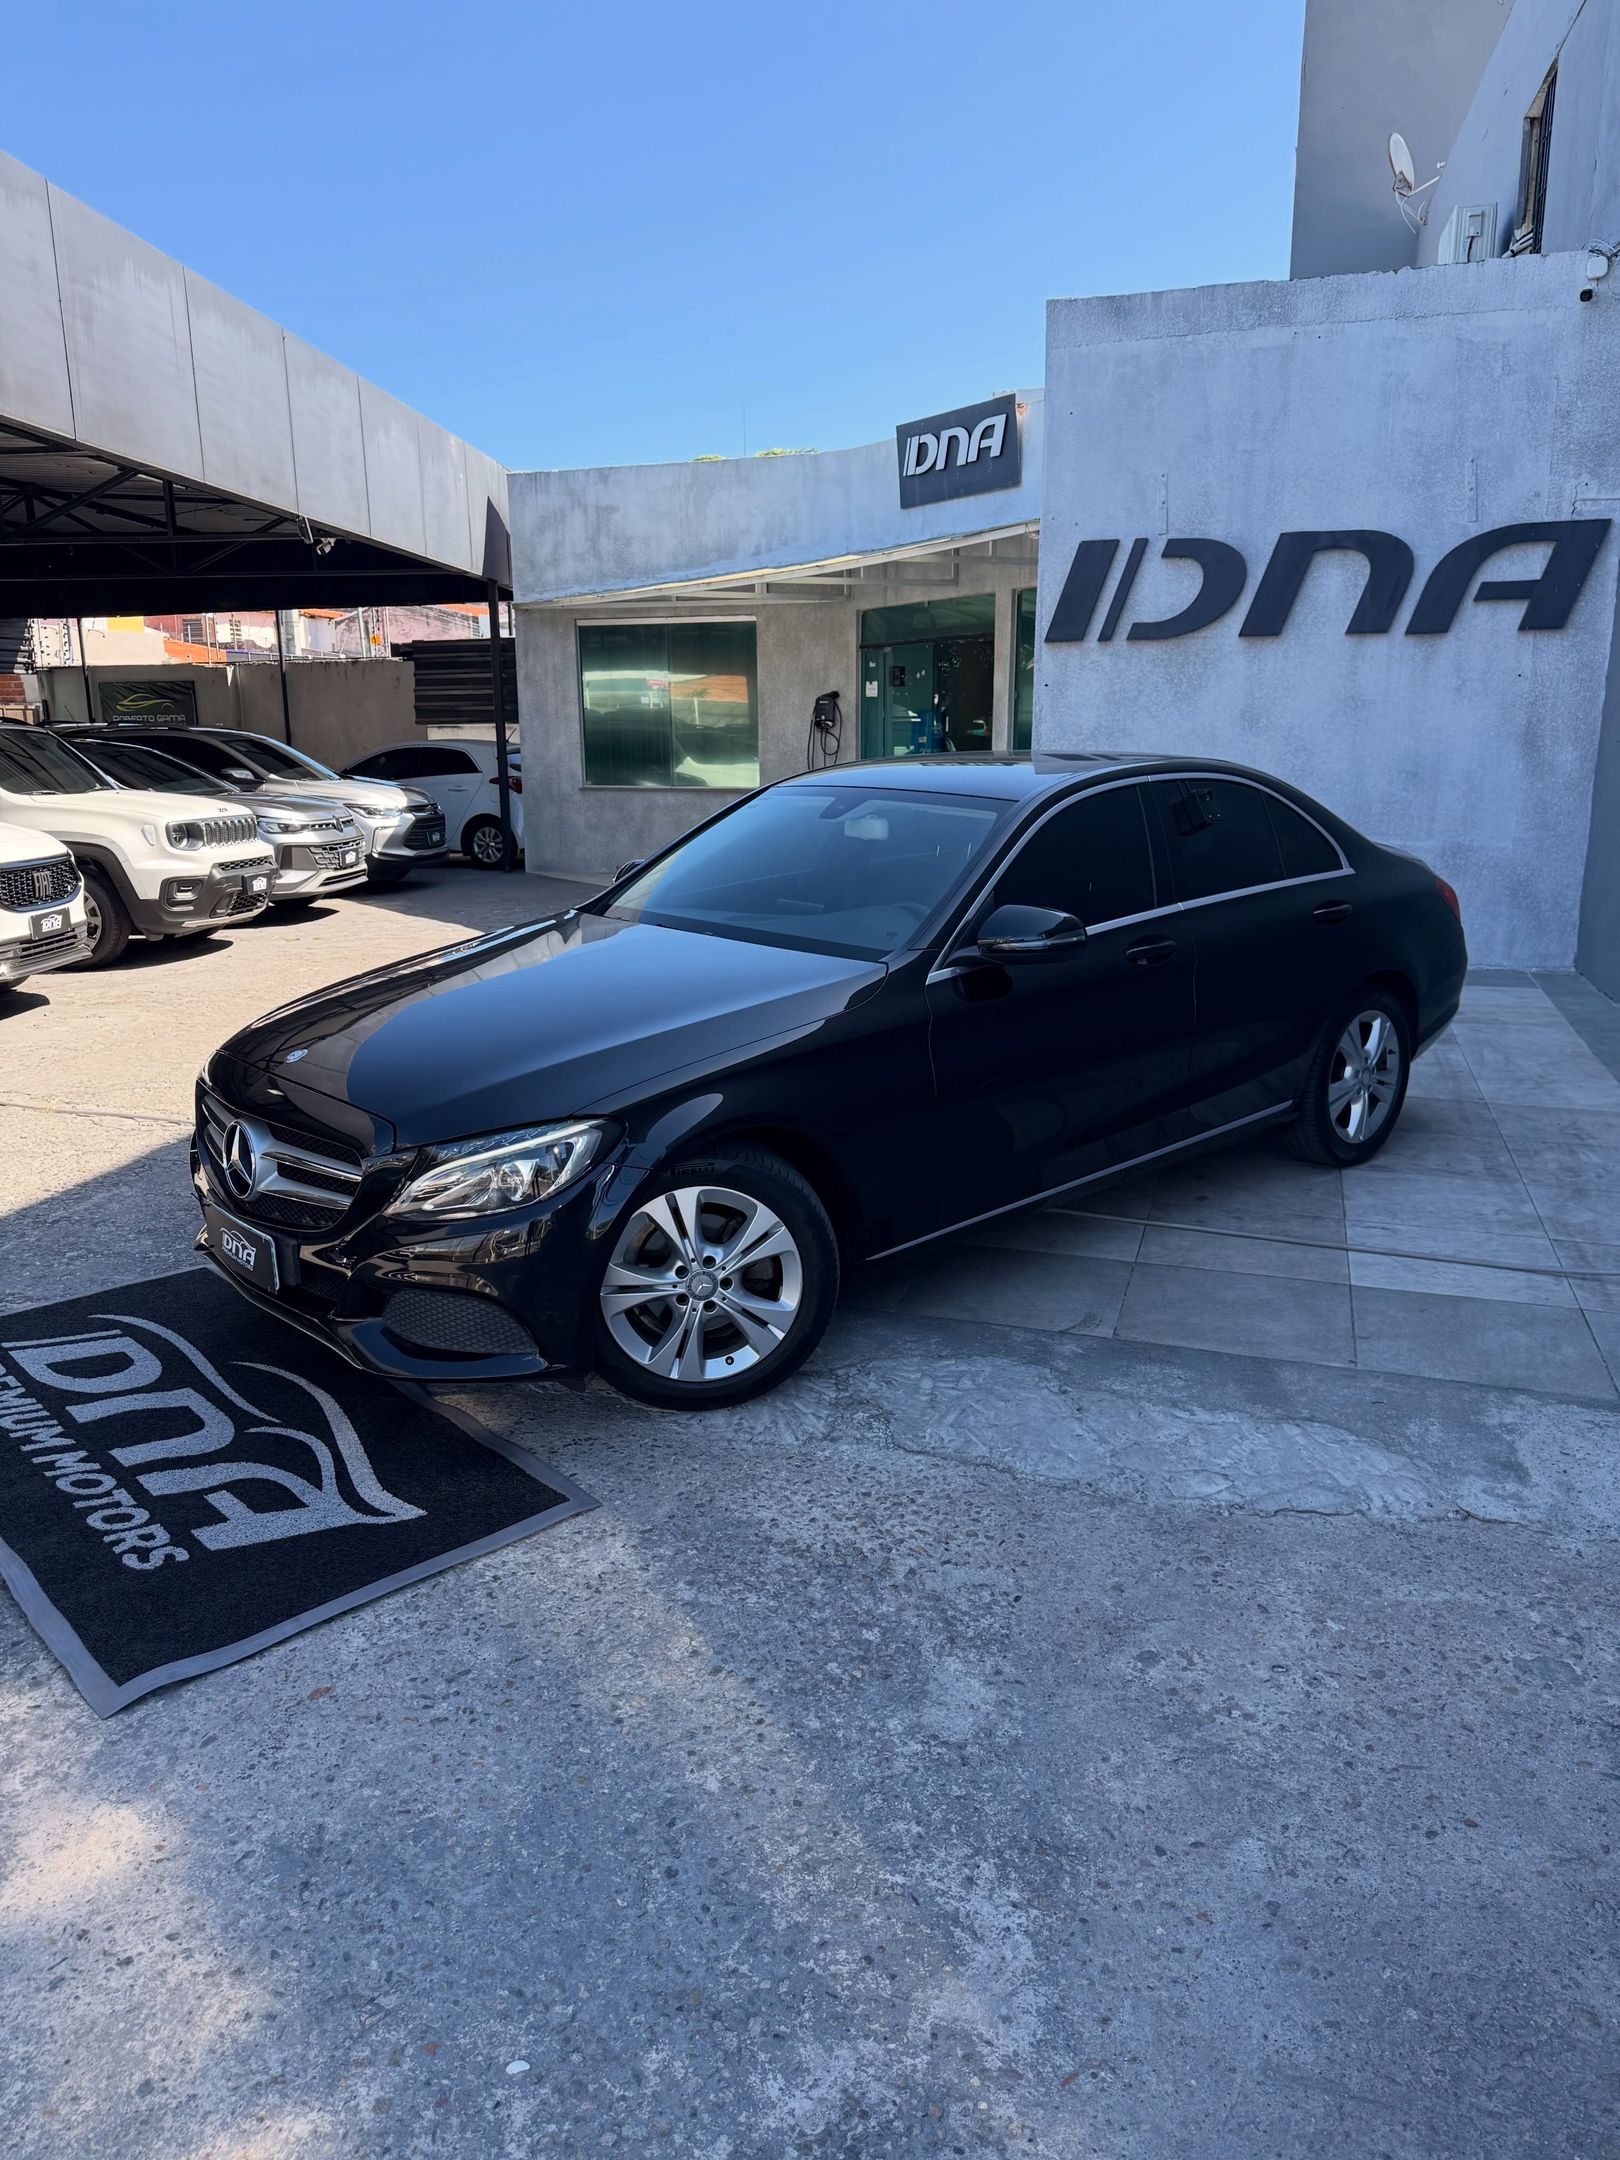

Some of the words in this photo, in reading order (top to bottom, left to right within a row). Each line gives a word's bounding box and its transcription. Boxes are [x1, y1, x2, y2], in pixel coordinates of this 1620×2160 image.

[903, 413, 1007, 477] DNA
[1044, 518, 1612, 643] DNA
[33, 870, 52, 899] FIAT
[222, 1231, 256, 1266] DNA
[1, 1329, 428, 1550] DNA
[31, 1450, 190, 1570] MOTORS
